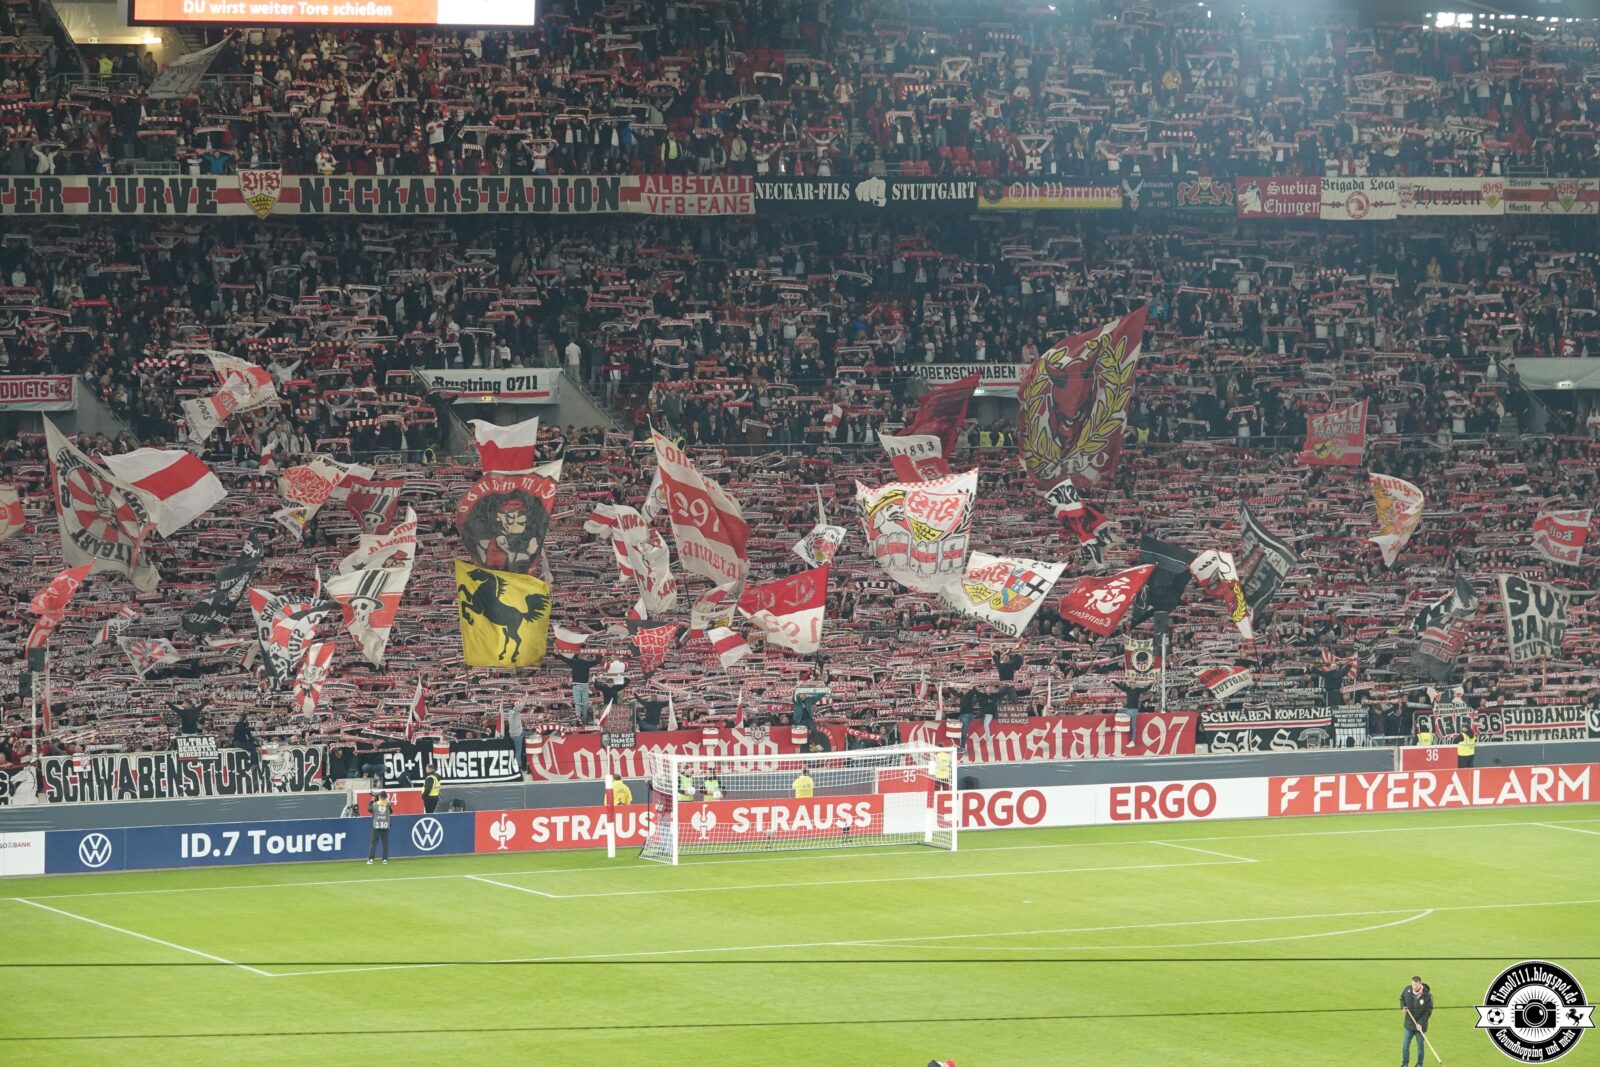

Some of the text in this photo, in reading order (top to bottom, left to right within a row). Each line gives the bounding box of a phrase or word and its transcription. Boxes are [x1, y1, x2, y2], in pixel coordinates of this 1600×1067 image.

[184, 0, 393, 17] DU wirst weiter Tore schießen
[643, 175, 752, 194] ALBSTADT
[754, 181, 977, 201] NECKAR-FILS STUTTGART
[1007, 181, 1041, 202] Old
[1043, 180, 1121, 202] Warriors
[1266, 180, 1318, 197] Suebia
[1321, 179, 1395, 193] Brigada Loca
[87, 177, 218, 214] KURVE
[299, 177, 621, 213] NECKARSTADION
[648, 194, 752, 215] VFB-FANS
[920, 365, 1017, 380] OBERSCHWABEN
[432, 375, 538, 393] Brustring 0711
[1200, 709, 1272, 724] SCHWABEN
[1274, 706, 1332, 720] KOMPANIE
[1503, 705, 1586, 725] SÜDBANDE
[177, 736, 216, 747] ULTRAS
[1140, 715, 1190, 757] 97
[1505, 727, 1587, 742] STUTTGART
[383, 752, 424, 778] 50+1
[1425, 749, 1439, 762] 36
[46, 750, 273, 803] SCHWABENSTURM
[902, 769, 917, 783] 35
[1313, 766, 1592, 814] FLYERALARM
[936, 788, 1047, 828] ERGO
[1109, 782, 1218, 821] ERGO
[530, 810, 658, 844] STRAUS
[731, 801, 873, 834] STRAUSS
[180, 830, 347, 858] ID.7 Tourer
